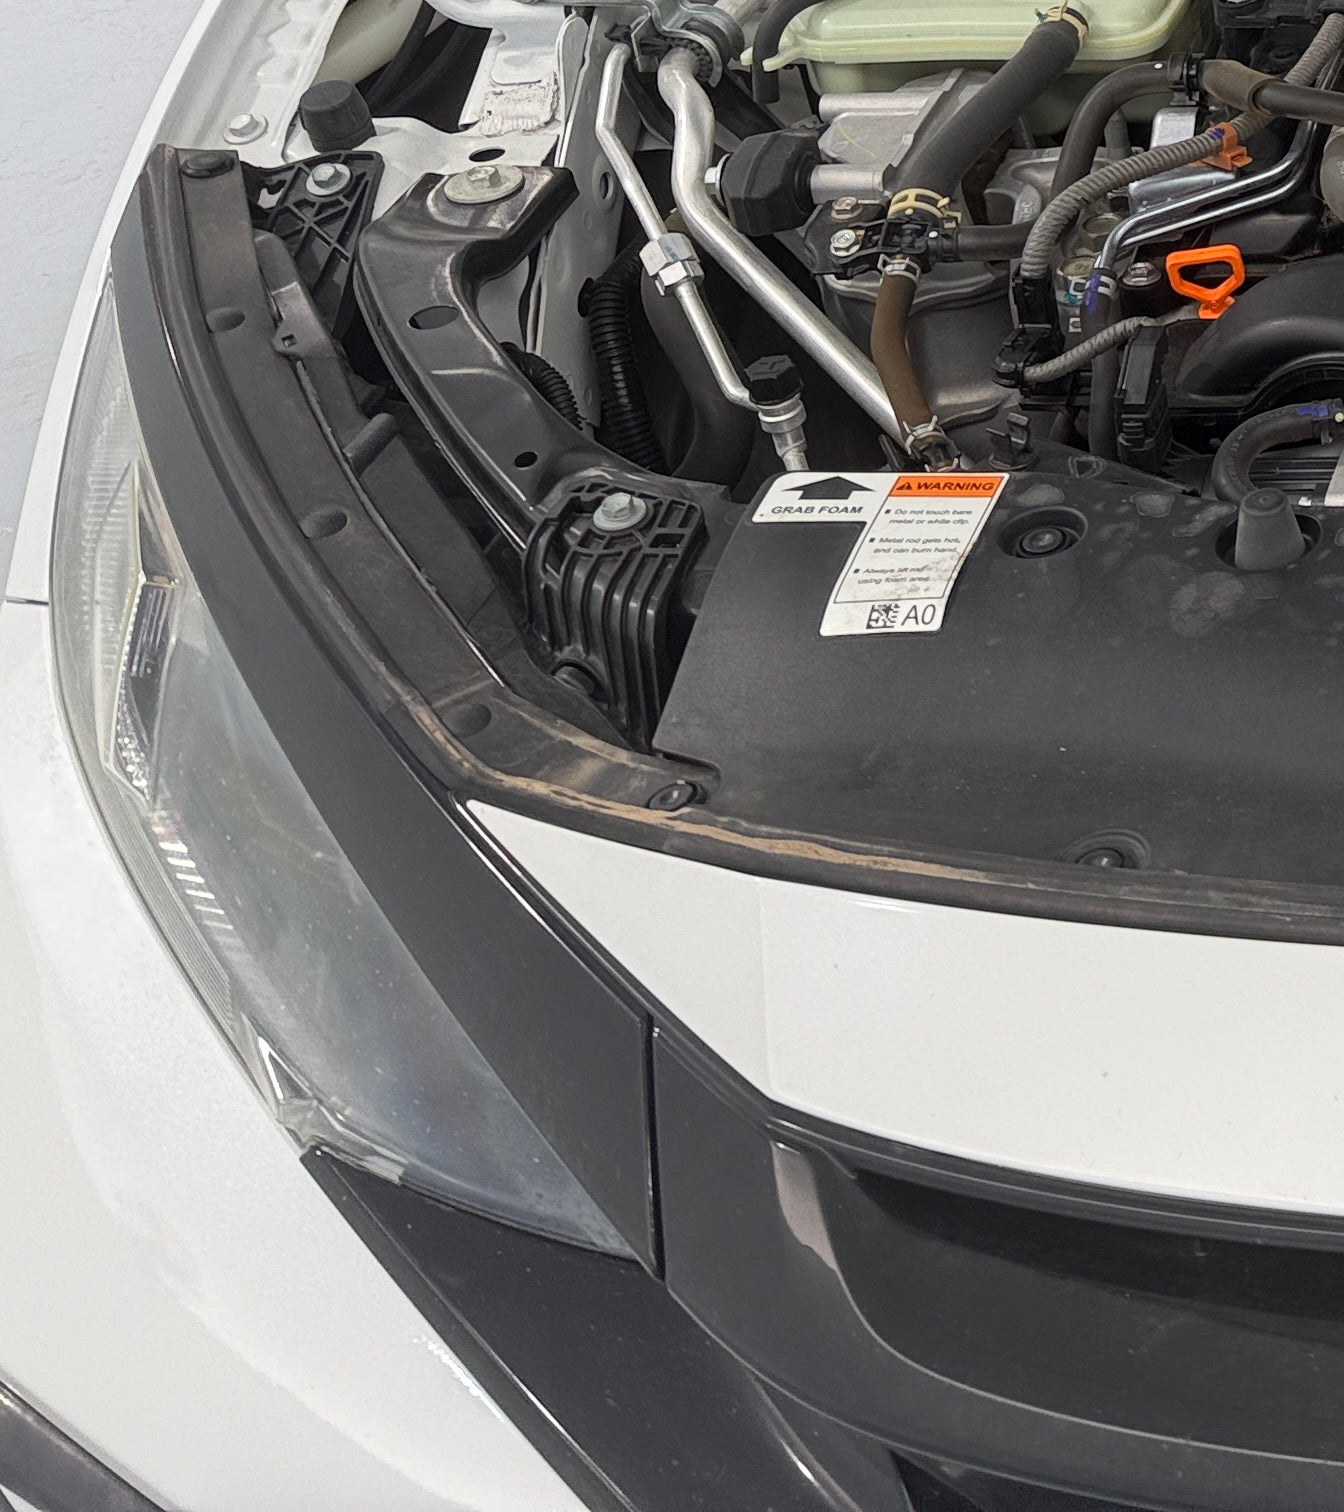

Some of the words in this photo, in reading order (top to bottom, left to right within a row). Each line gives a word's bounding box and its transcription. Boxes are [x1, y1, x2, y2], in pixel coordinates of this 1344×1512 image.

[917, 482, 995, 491] WARNING
[771, 506, 815, 515] GRAB
[818, 506, 863, 514] FOAM
[901, 604, 936, 626] A0
